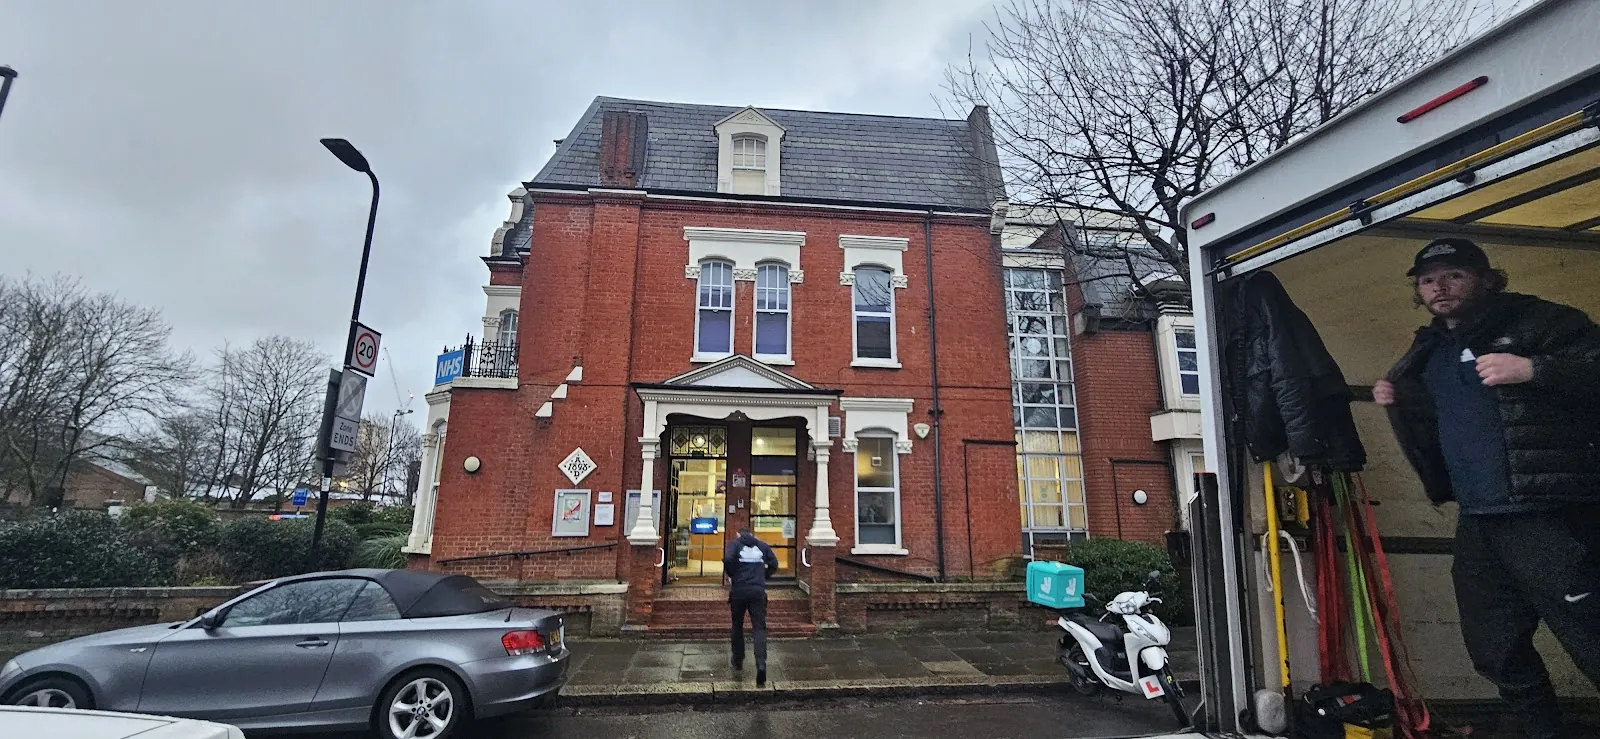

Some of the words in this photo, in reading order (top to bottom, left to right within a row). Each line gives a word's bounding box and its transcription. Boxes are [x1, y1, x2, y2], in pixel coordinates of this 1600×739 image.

[359, 341, 374, 359] 20
[437, 356, 462, 379] NHS
[340, 422, 353, 433] Zone
[333, 432, 355, 447] ENDS
[567, 462, 588, 472] 1898
[1145, 681, 1159, 692] L
